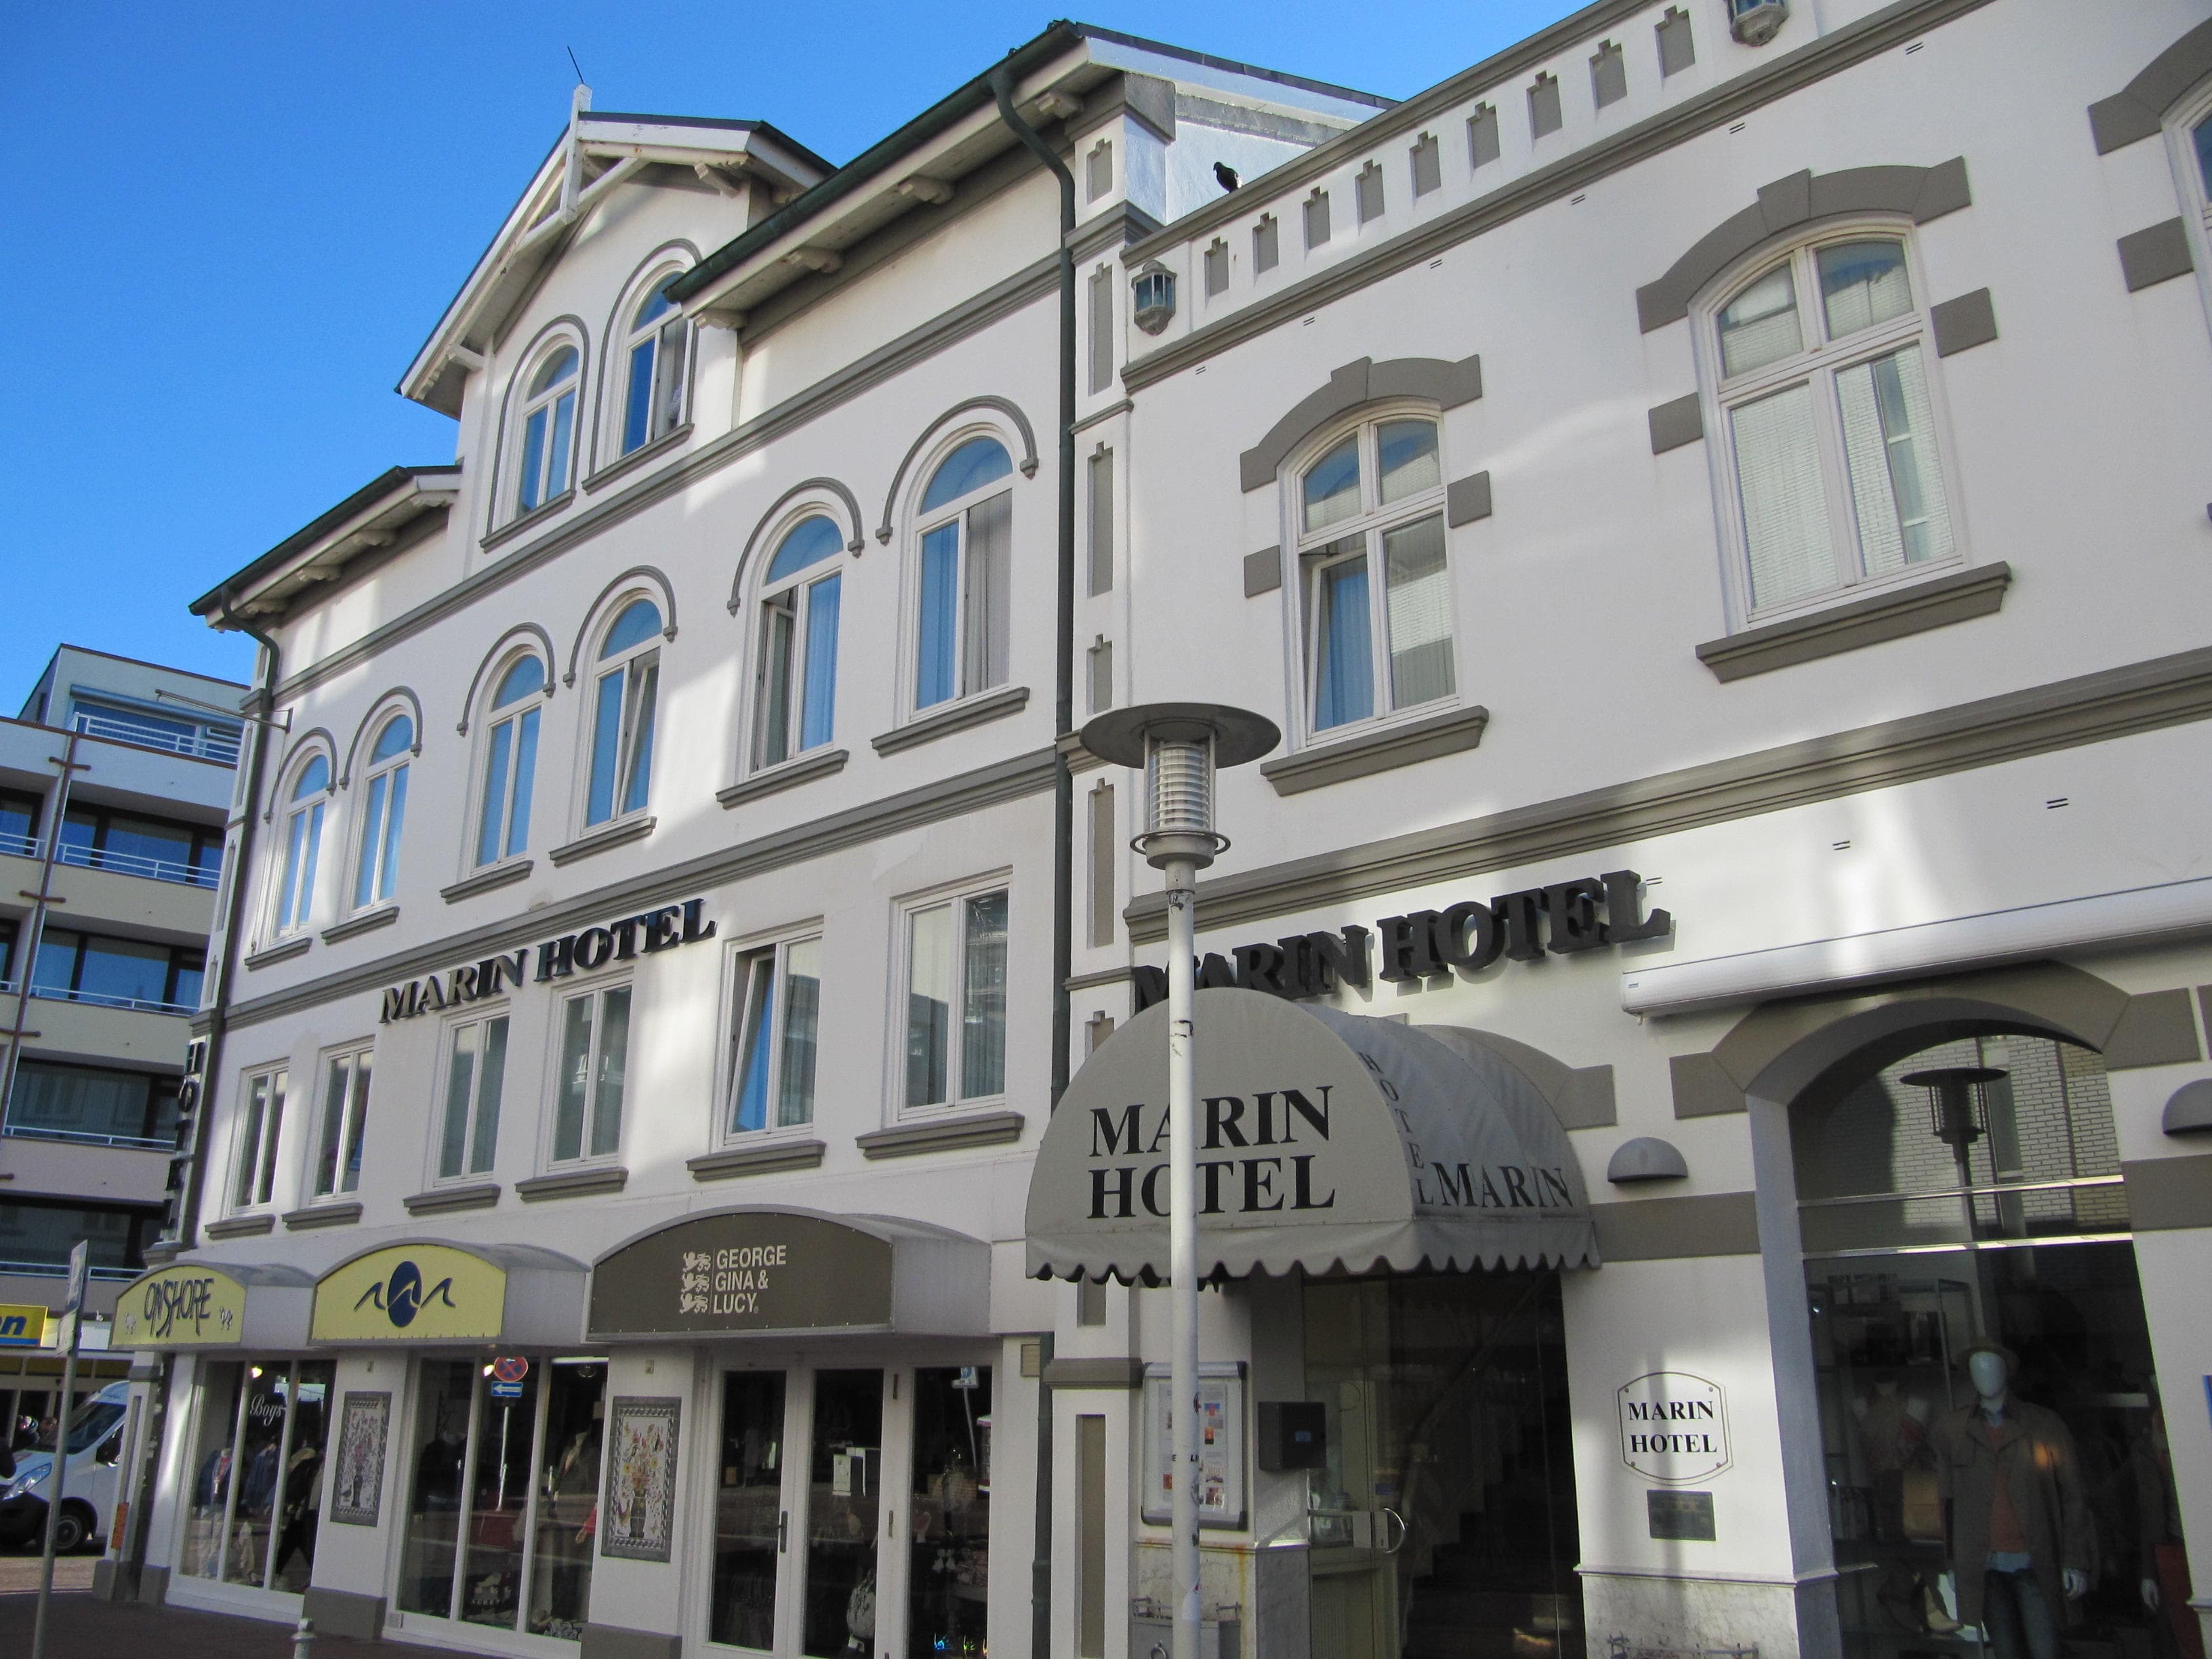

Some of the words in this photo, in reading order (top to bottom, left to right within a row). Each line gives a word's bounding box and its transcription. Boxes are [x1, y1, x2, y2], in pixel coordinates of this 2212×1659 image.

[1378, 870, 1671, 983] HOTEL
[378, 948, 529, 1023] MARIN
[533, 898, 716, 982] HOTEL
[1431, 1162, 1573, 1208] MARIN
[716, 1245, 787, 1269] GEORGE
[715, 1270, 754, 1292] GINA
[758, 1269, 769, 1289] &
[144, 1278, 214, 1338] ONSHORE
[249, 1393, 287, 1426] Boys
[1628, 1401, 1714, 1420] MARIN
[1630, 1434, 1717, 1453] HOTEL
